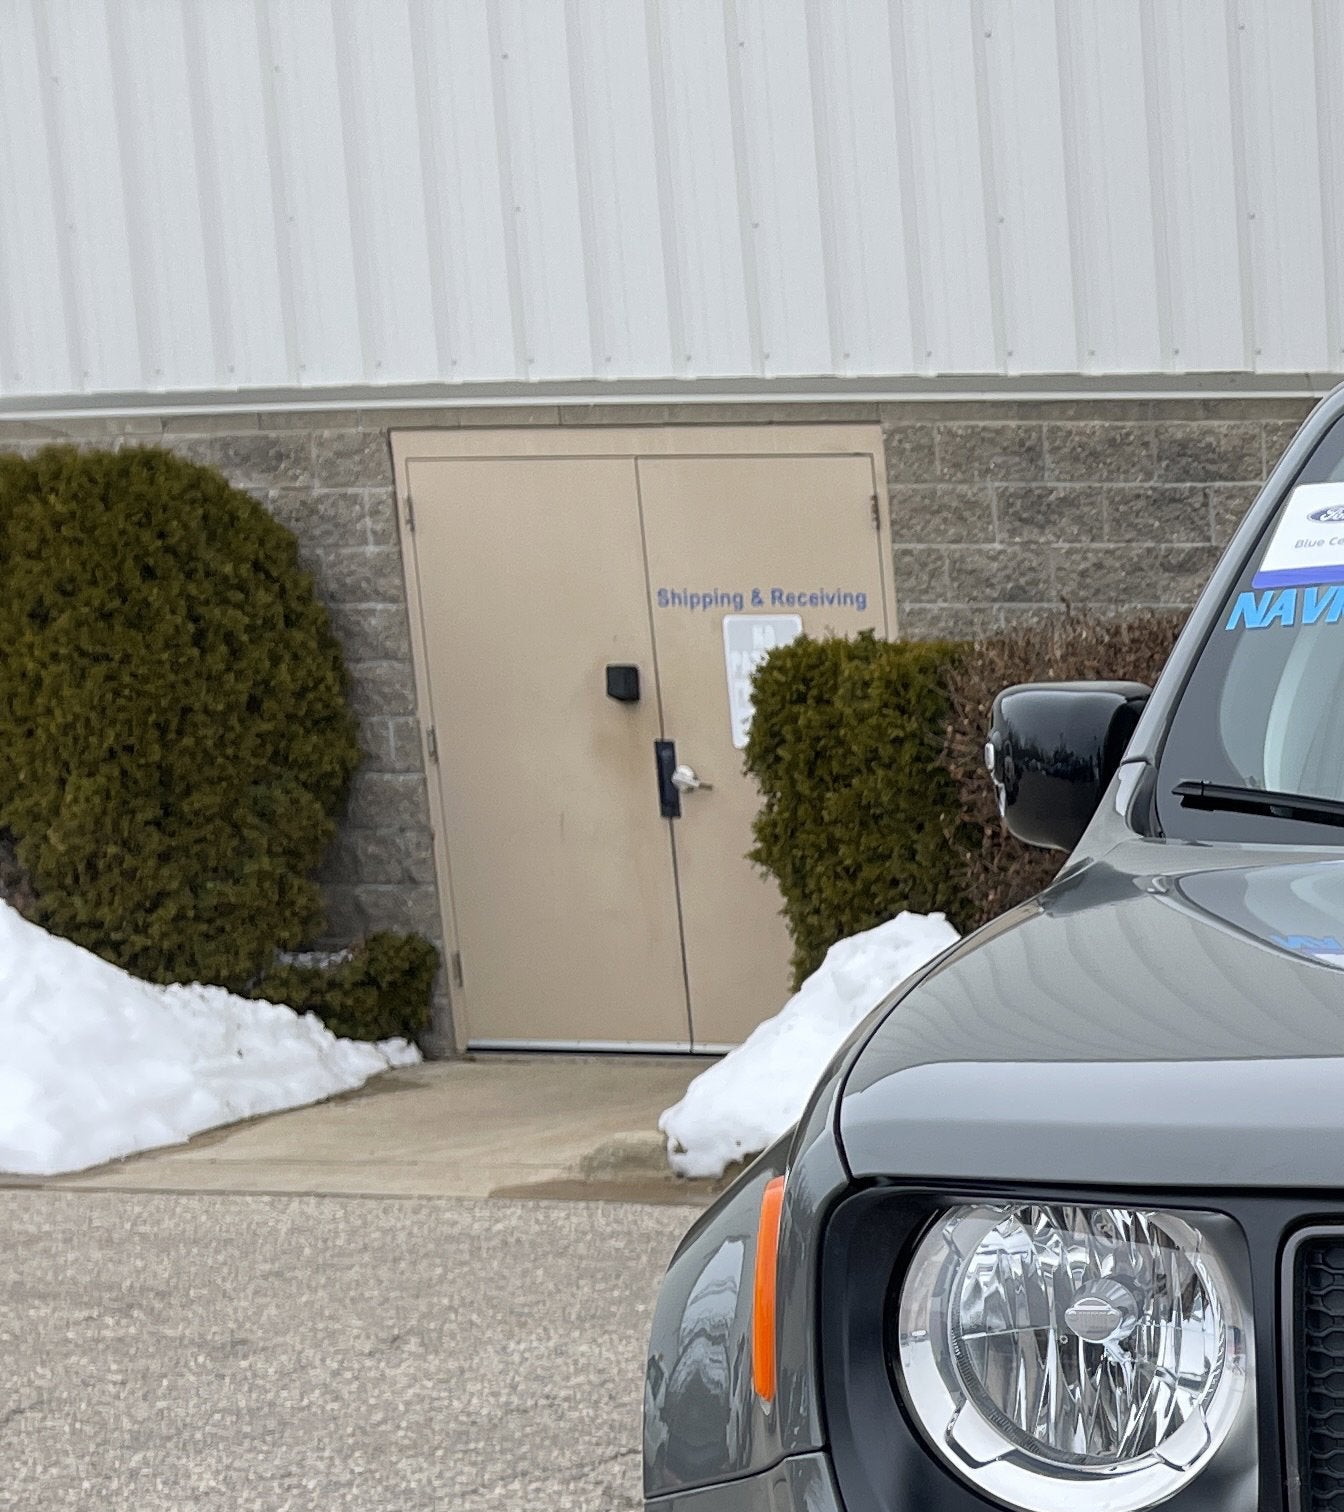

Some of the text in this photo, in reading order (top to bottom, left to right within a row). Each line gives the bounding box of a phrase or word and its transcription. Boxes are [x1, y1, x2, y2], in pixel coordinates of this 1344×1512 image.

[1294, 538, 1326, 549] Blue
[657, 587, 868, 612] Shipping & Receiving
